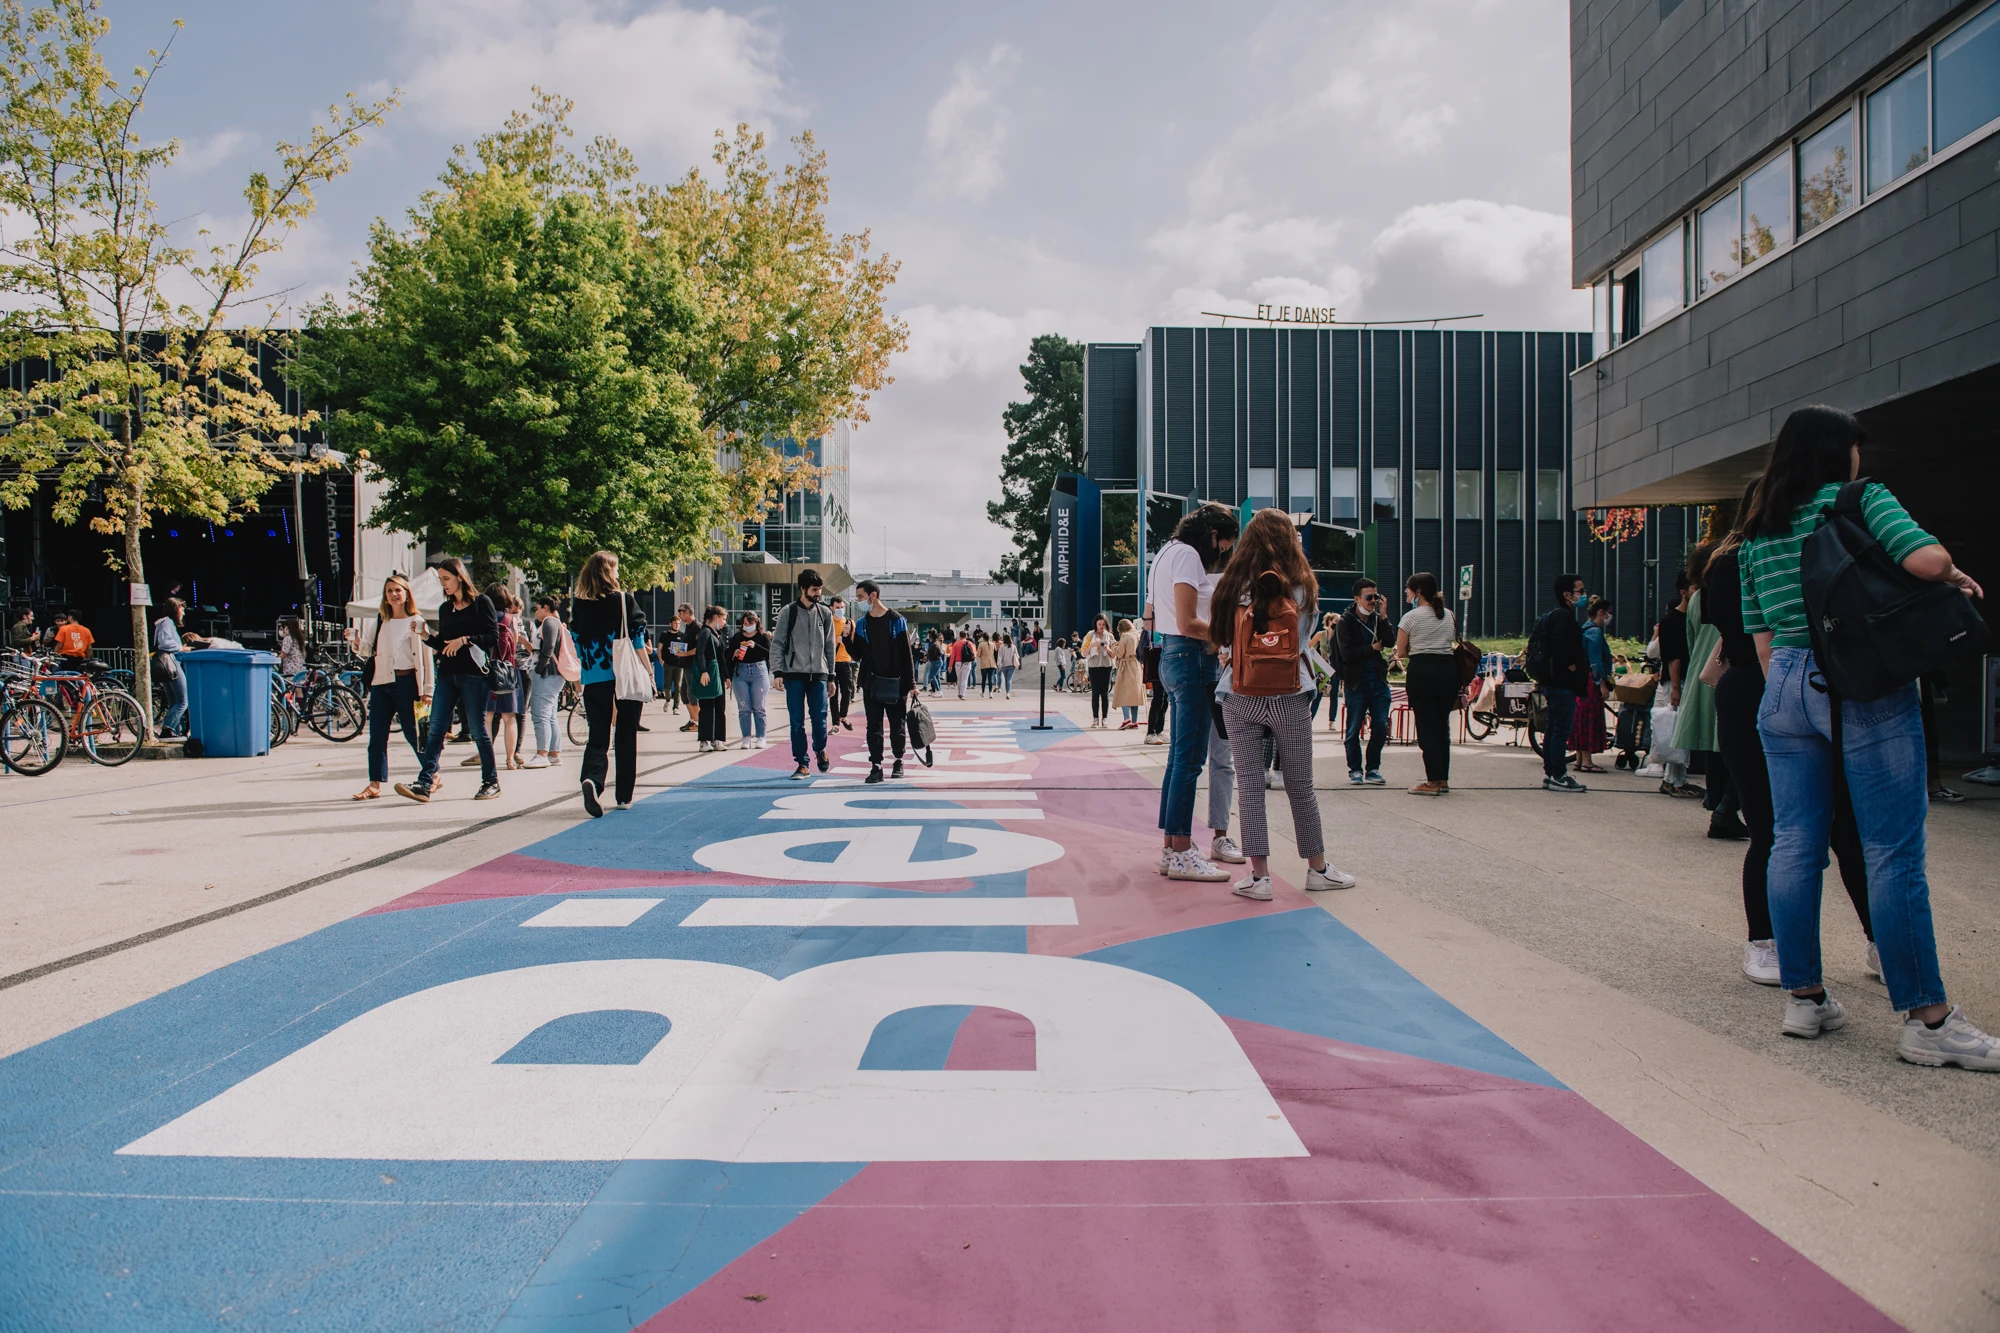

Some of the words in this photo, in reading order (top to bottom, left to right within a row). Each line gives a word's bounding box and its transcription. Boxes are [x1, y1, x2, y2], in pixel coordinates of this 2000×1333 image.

[1257, 304, 1273, 320] ET
[1276, 305, 1291, 322] JE
[1295, 306, 1336, 323] DANSE
